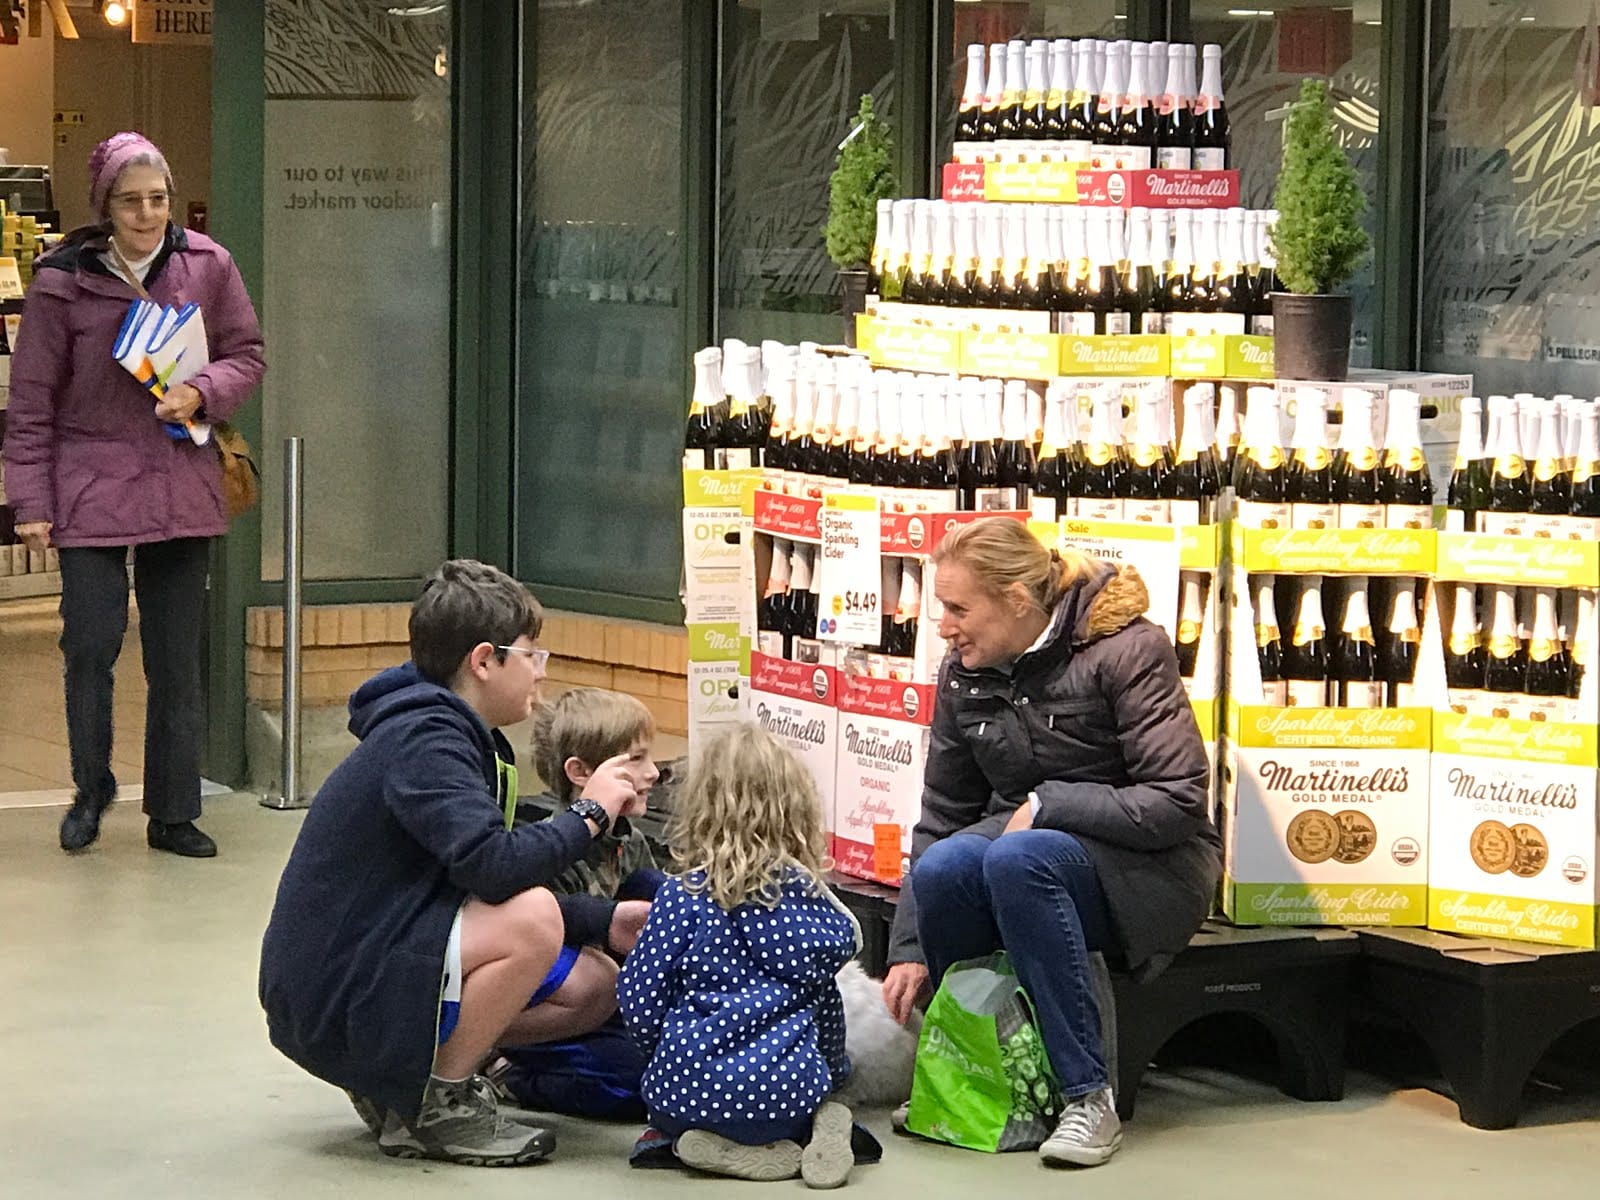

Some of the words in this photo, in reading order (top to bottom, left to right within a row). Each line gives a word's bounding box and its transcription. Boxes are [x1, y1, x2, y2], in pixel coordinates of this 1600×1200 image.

[154, 9, 212, 34] HERE
[1146, 174, 1229, 197] Martinelli's
[1239, 341, 1274, 363] Mar
[698, 475, 743, 495] Mart
[825, 517, 853, 532] Organic
[1067, 523, 1089, 533] Sale
[825, 532, 859, 548] Sparkling
[825, 546, 844, 559] Cider
[845, 590, 876, 612] $4.49
[704, 629, 740, 649] Mar
[757, 702, 826, 744] Martinelli's
[1256, 708, 1354, 735] Sparkling
[1356, 710, 1416, 733] Cider
[845, 723, 913, 766] Martinelli's
[1274, 735, 1336, 745] CERTIFIED
[1343, 735, 1397, 745] ORGANIC
[860, 776, 891, 792] ORGANIC
[1259, 760, 1408, 792] Martinelli's
[1292, 793, 1327, 803] GOLD
[1332, 794, 1374, 803] MEDAL
[1448, 768, 1577, 810] Martinelli's
[1475, 803, 1504, 814] GOLD
[1509, 806, 1545, 818] MEDAL
[1251, 885, 1349, 913] Sparkling
[1350, 887, 1409, 910] Cider
[1270, 912, 1329, 923] CERTIFIED
[1337, 912, 1391, 923] ORGANIC
[1440, 893, 1525, 928] Sparkling
[1525, 903, 1578, 928] Cider
[1456, 919, 1508, 934] CERTIFIED
[1515, 926, 1562, 941] ORGANIC
